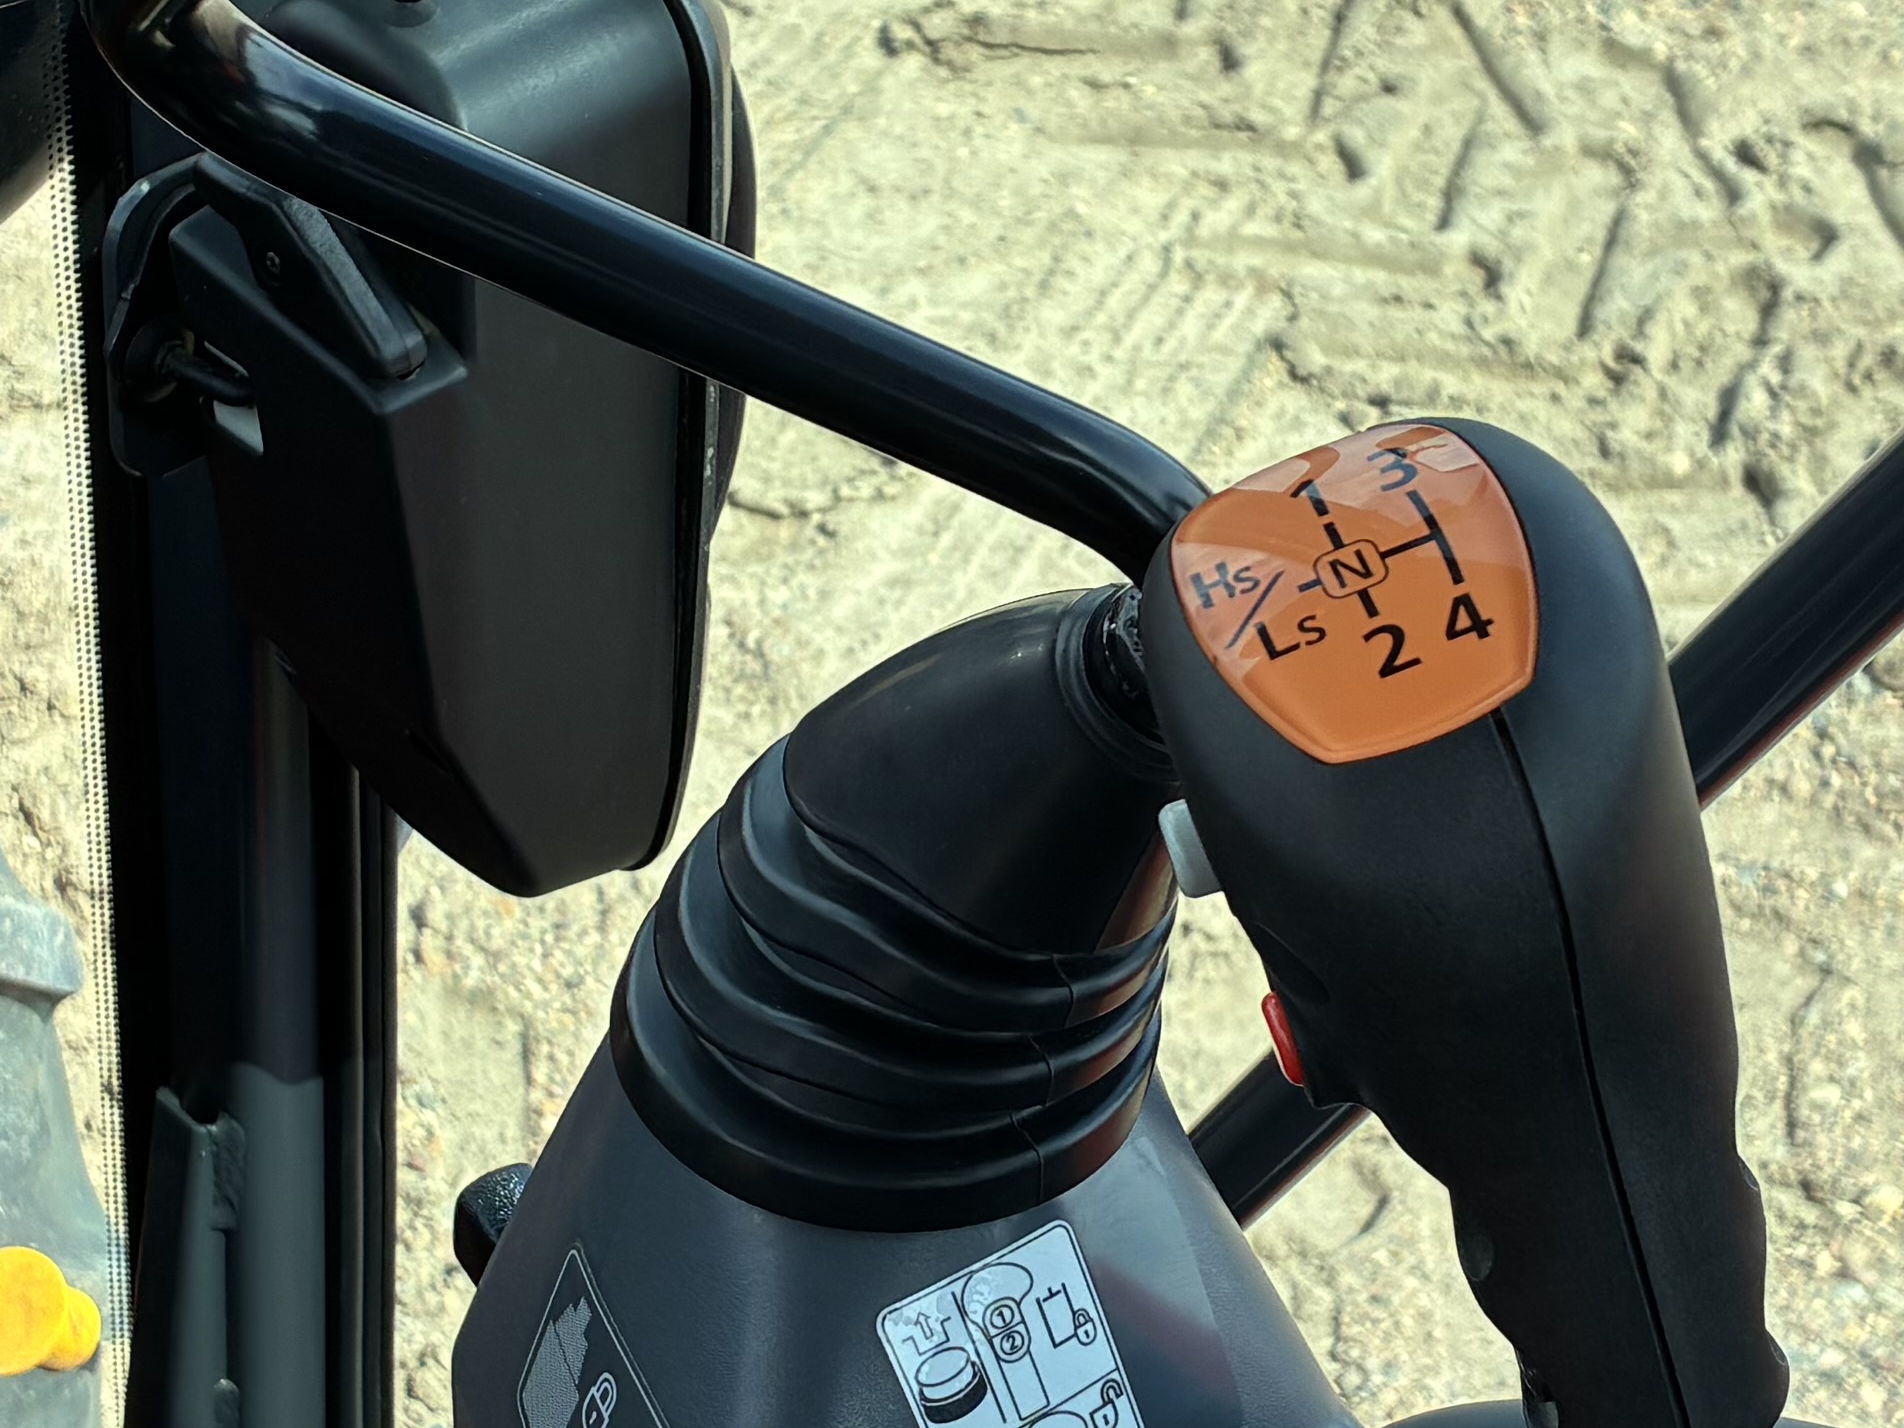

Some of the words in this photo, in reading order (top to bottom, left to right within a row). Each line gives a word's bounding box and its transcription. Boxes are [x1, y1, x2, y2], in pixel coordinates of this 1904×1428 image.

[1289, 479, 1329, 517] 1
[1366, 446, 1420, 492] 3
[1329, 550, 1372, 587] N
[1362, 623, 1423, 678] 2
[1444, 591, 1495, 641] 4
